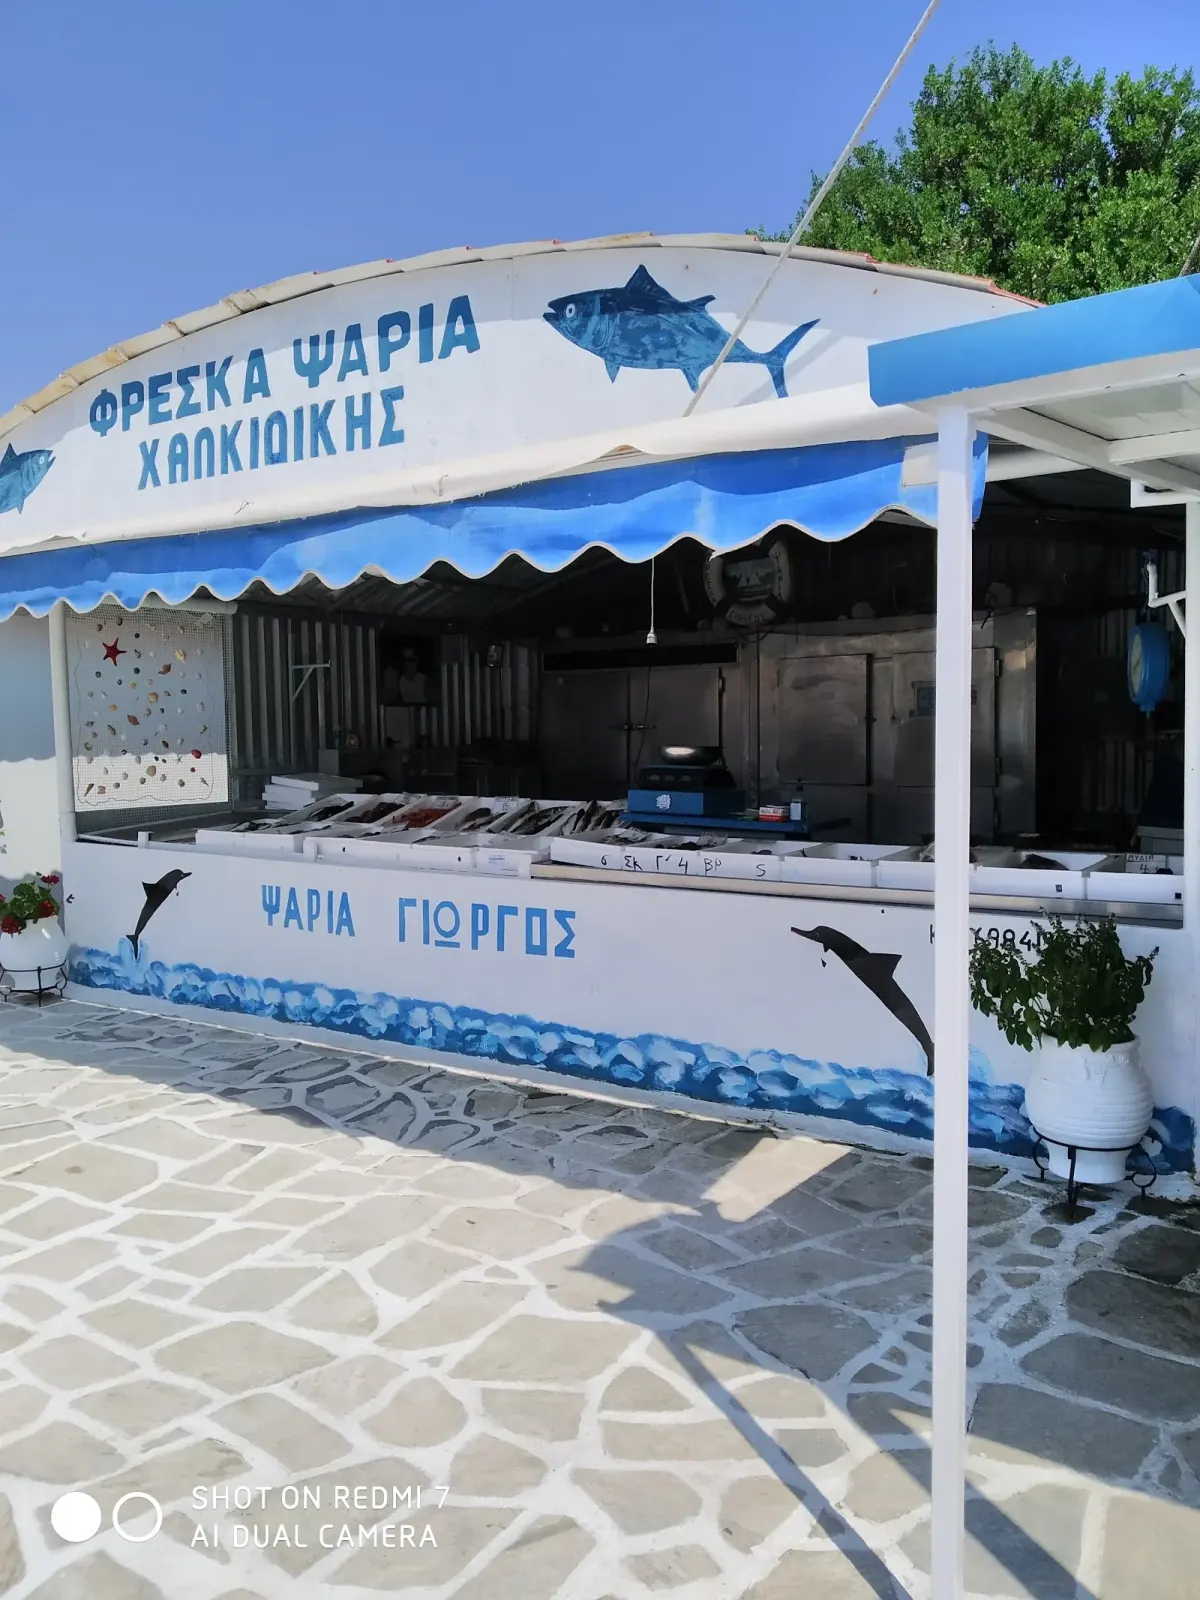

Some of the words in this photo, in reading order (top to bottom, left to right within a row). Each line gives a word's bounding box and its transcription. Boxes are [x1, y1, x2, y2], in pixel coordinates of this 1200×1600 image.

[89, 348, 271, 437] ΦΡΕΣΚΑ
[293, 295, 480, 388] ΨΑΡΙΑ
[261, 885, 356, 937] ΨΑΡΙΑ
[398, 897, 576, 958] ΓΙΩΡΓΟΣ
